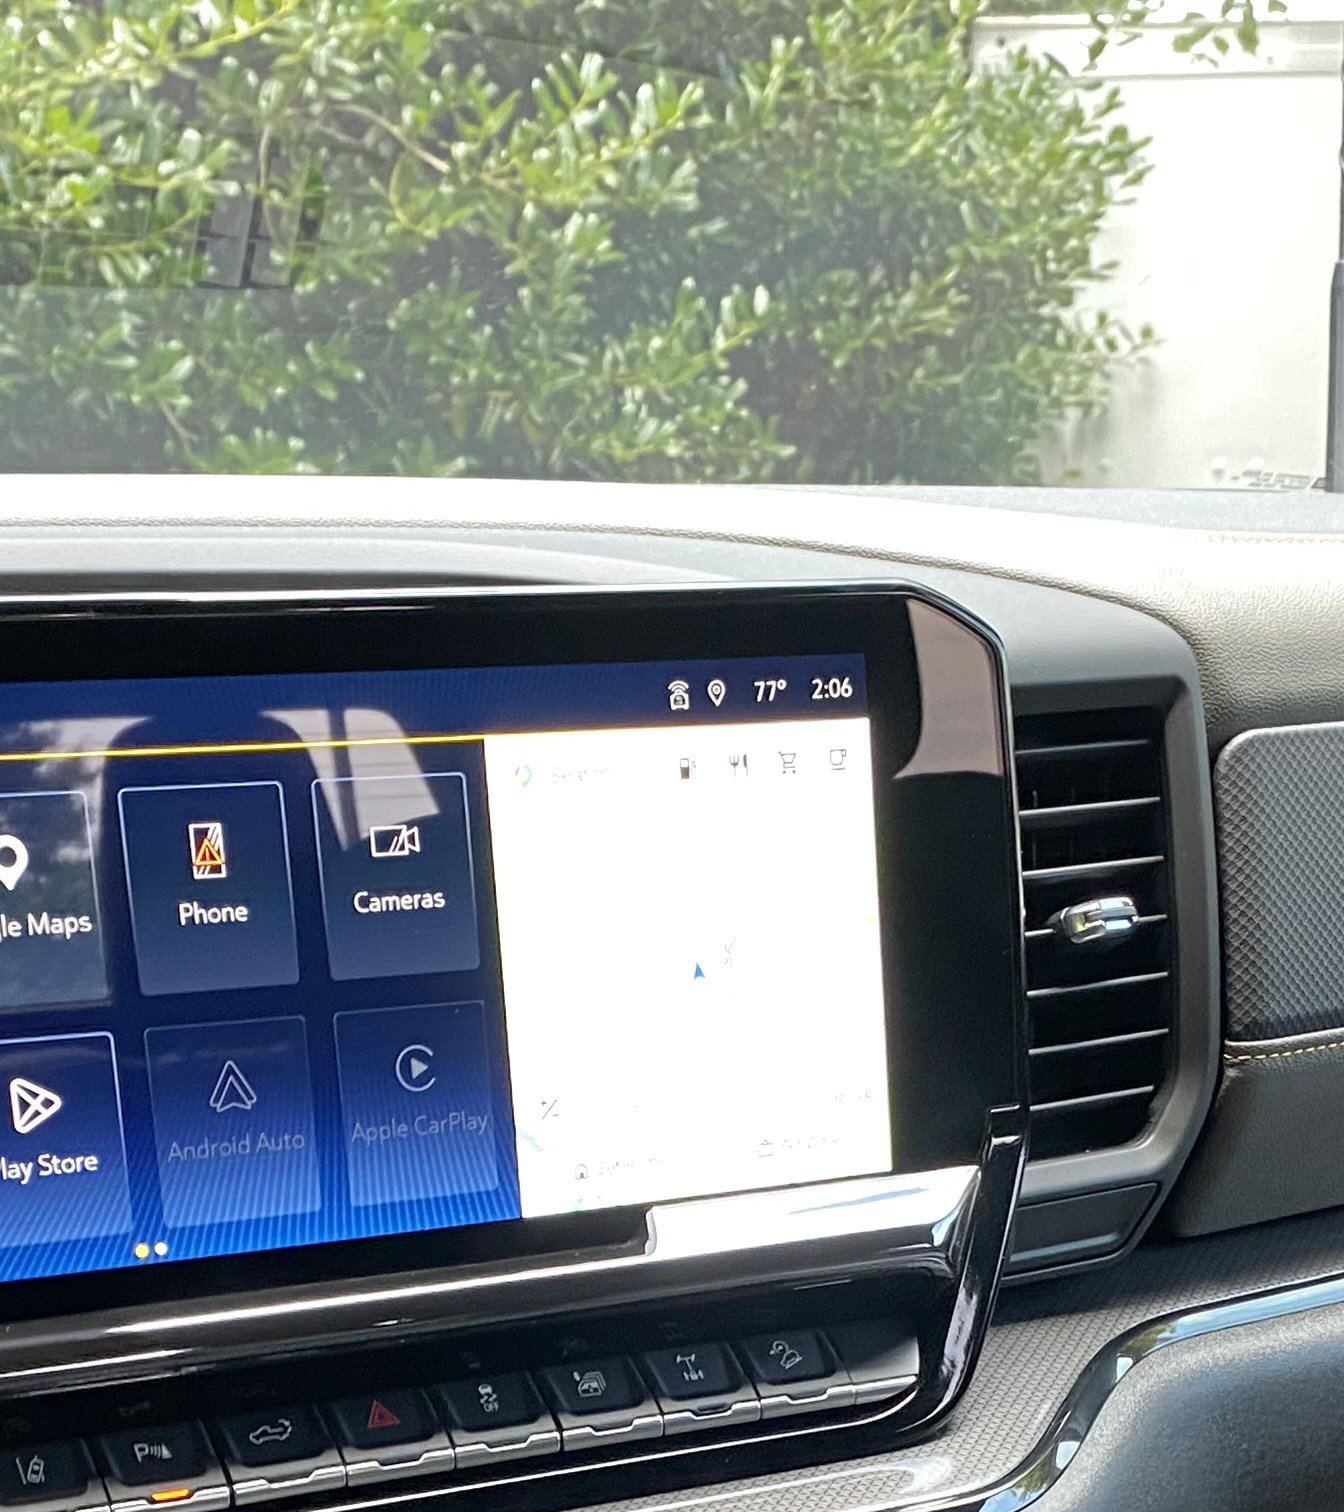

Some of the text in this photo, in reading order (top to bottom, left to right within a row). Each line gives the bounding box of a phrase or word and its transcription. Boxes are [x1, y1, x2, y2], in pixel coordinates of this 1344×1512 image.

[754, 677, 853, 702] 77° 2:06
[178, 902, 249, 926] Phone
[353, 890, 446, 915] Cameras
[27, 913, 92, 941] Maps
[352, 1112, 489, 1145] Apple CarPlay
[168, 1131, 305, 1163] Android Auto
[37, 1153, 99, 1176] Store
